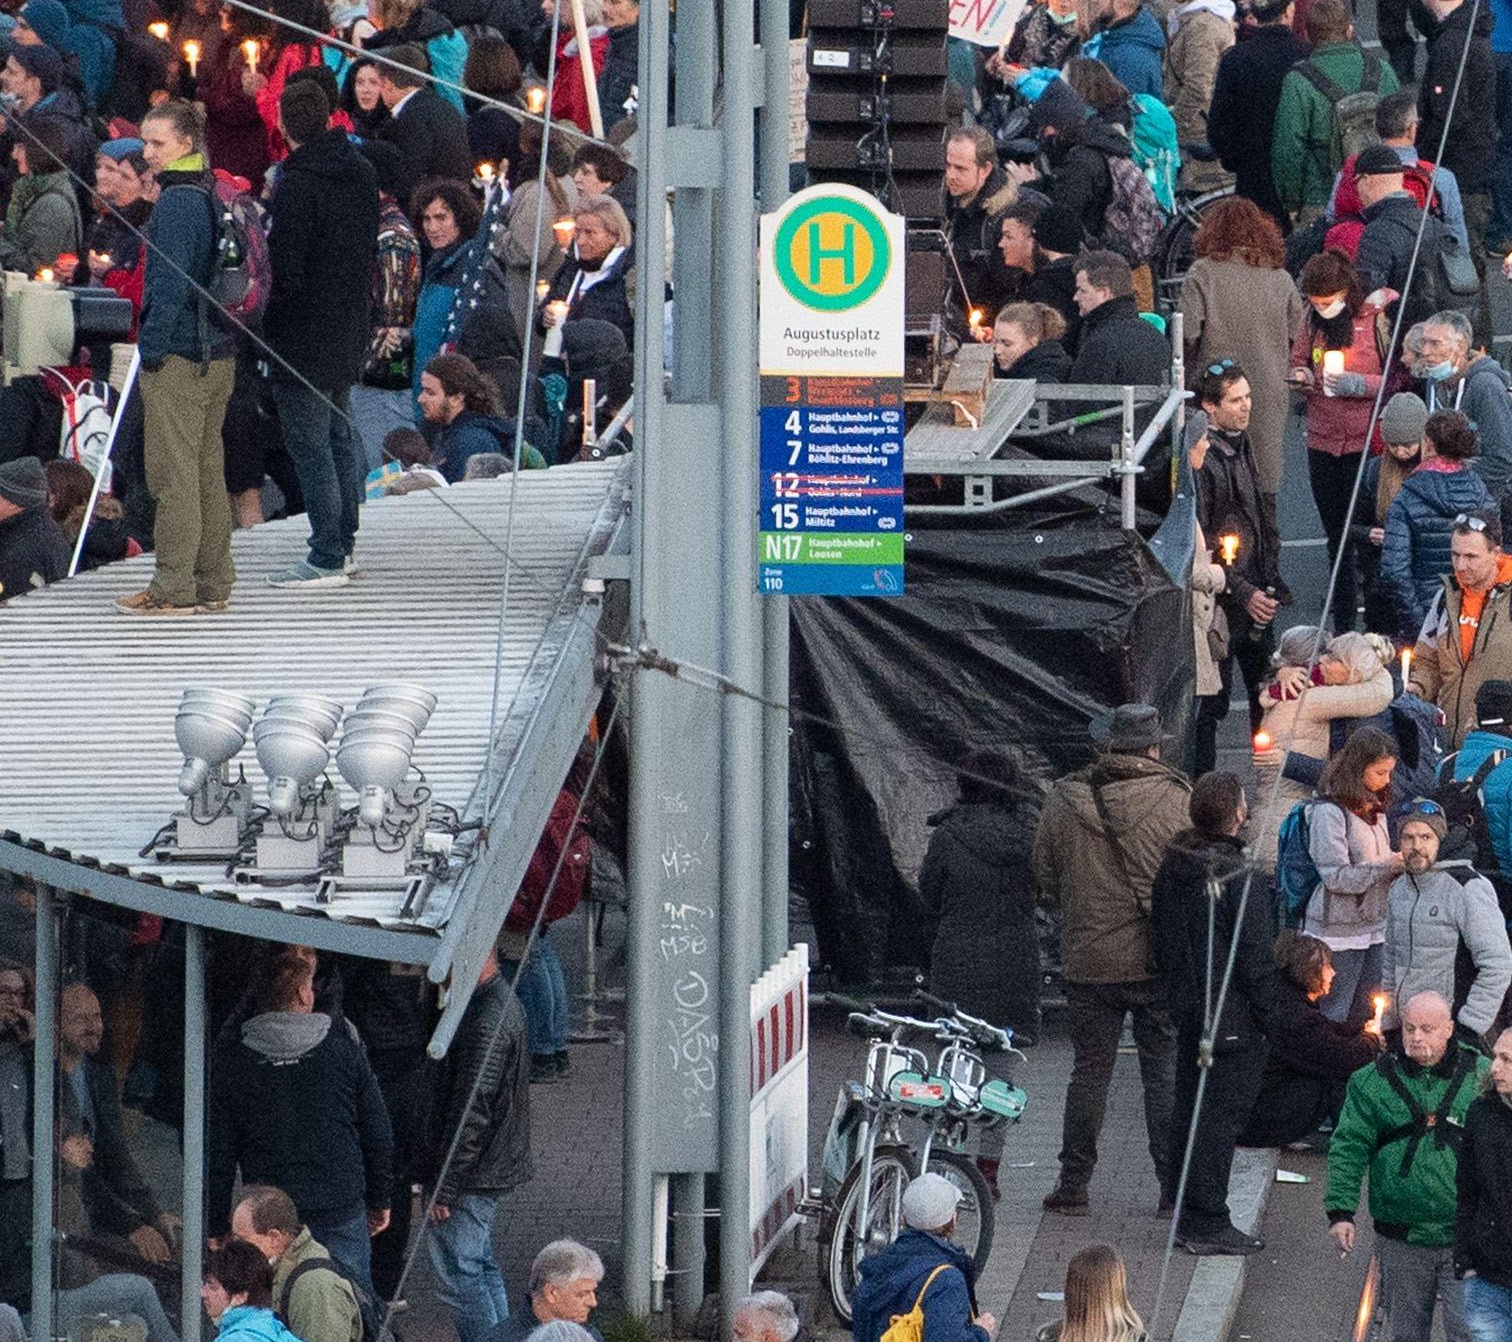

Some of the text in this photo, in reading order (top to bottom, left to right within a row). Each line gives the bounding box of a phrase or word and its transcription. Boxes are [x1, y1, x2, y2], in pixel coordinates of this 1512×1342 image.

[783, 327, 881, 343] Augustusplatz
[786, 346, 877, 359] Doppelhaltestelle
[784, 375, 801, 403] 3
[784, 410, 873, 436] 4 Hauptbahnhof
[838, 426, 885, 436] Landsberger
[786, 440, 873, 466] 7 Hauptbahnhof
[808, 454, 888, 467] Böhlitz-Ehrenberg
[774, 472, 800, 498] 12
[771, 503, 872, 529] 15 Hauptbahnhof
[805, 517, 836, 527] Miltitz
[765, 535, 875, 560] N17 Hauptbahnhof
[764, 577, 784, 590] 110
